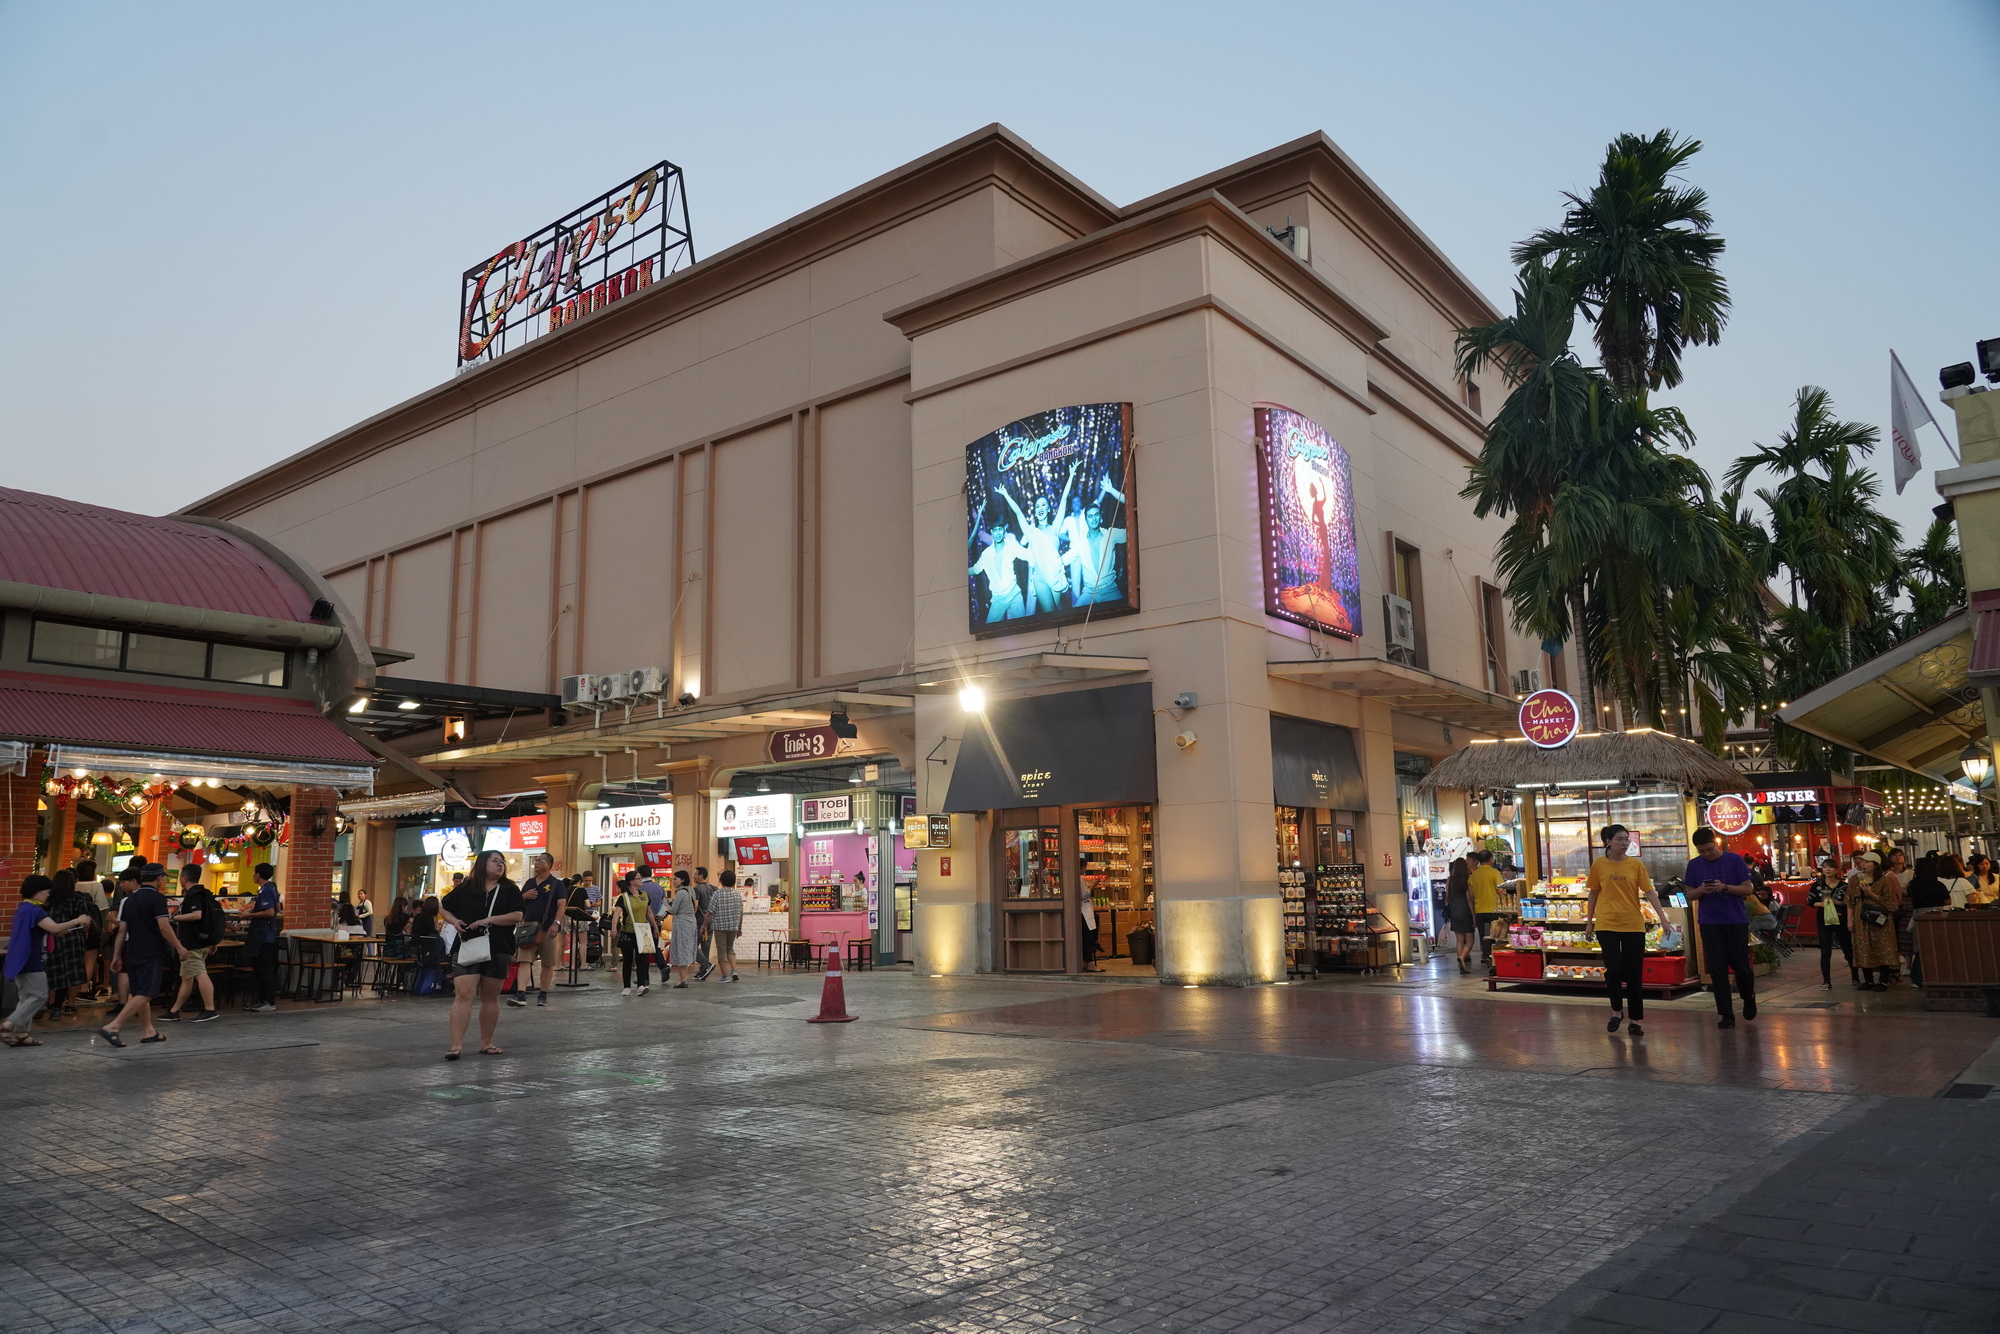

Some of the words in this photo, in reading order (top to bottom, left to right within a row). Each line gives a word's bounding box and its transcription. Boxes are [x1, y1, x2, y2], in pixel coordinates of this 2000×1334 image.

[460, 169, 658, 361] Calypso
[549, 258, 654, 332] BANGKOK
[997, 424, 1071, 472] Calypso
[1039, 444, 1073, 462] BANGKOK
[1287, 428, 1329, 462] Calypso
[1525, 699, 1572, 719] Thai
[1532, 717, 1565, 725] MARKET
[1527, 724, 1570, 742] Thai
[783, 733, 811, 753] โกดัง
[812, 734, 825, 755] 3
[1021, 768, 1051, 784] spice
[819, 799, 847, 809] TOBI
[1747, 789, 1816, 804] LOBSTER
[820, 811, 832, 820] ice
[833, 810, 847, 819] bar
[1711, 801, 1746, 815] Thai
[1714, 818, 1745, 831] Thai
[629, 830, 645, 838] MILK
[647, 829, 661, 837] BAR
